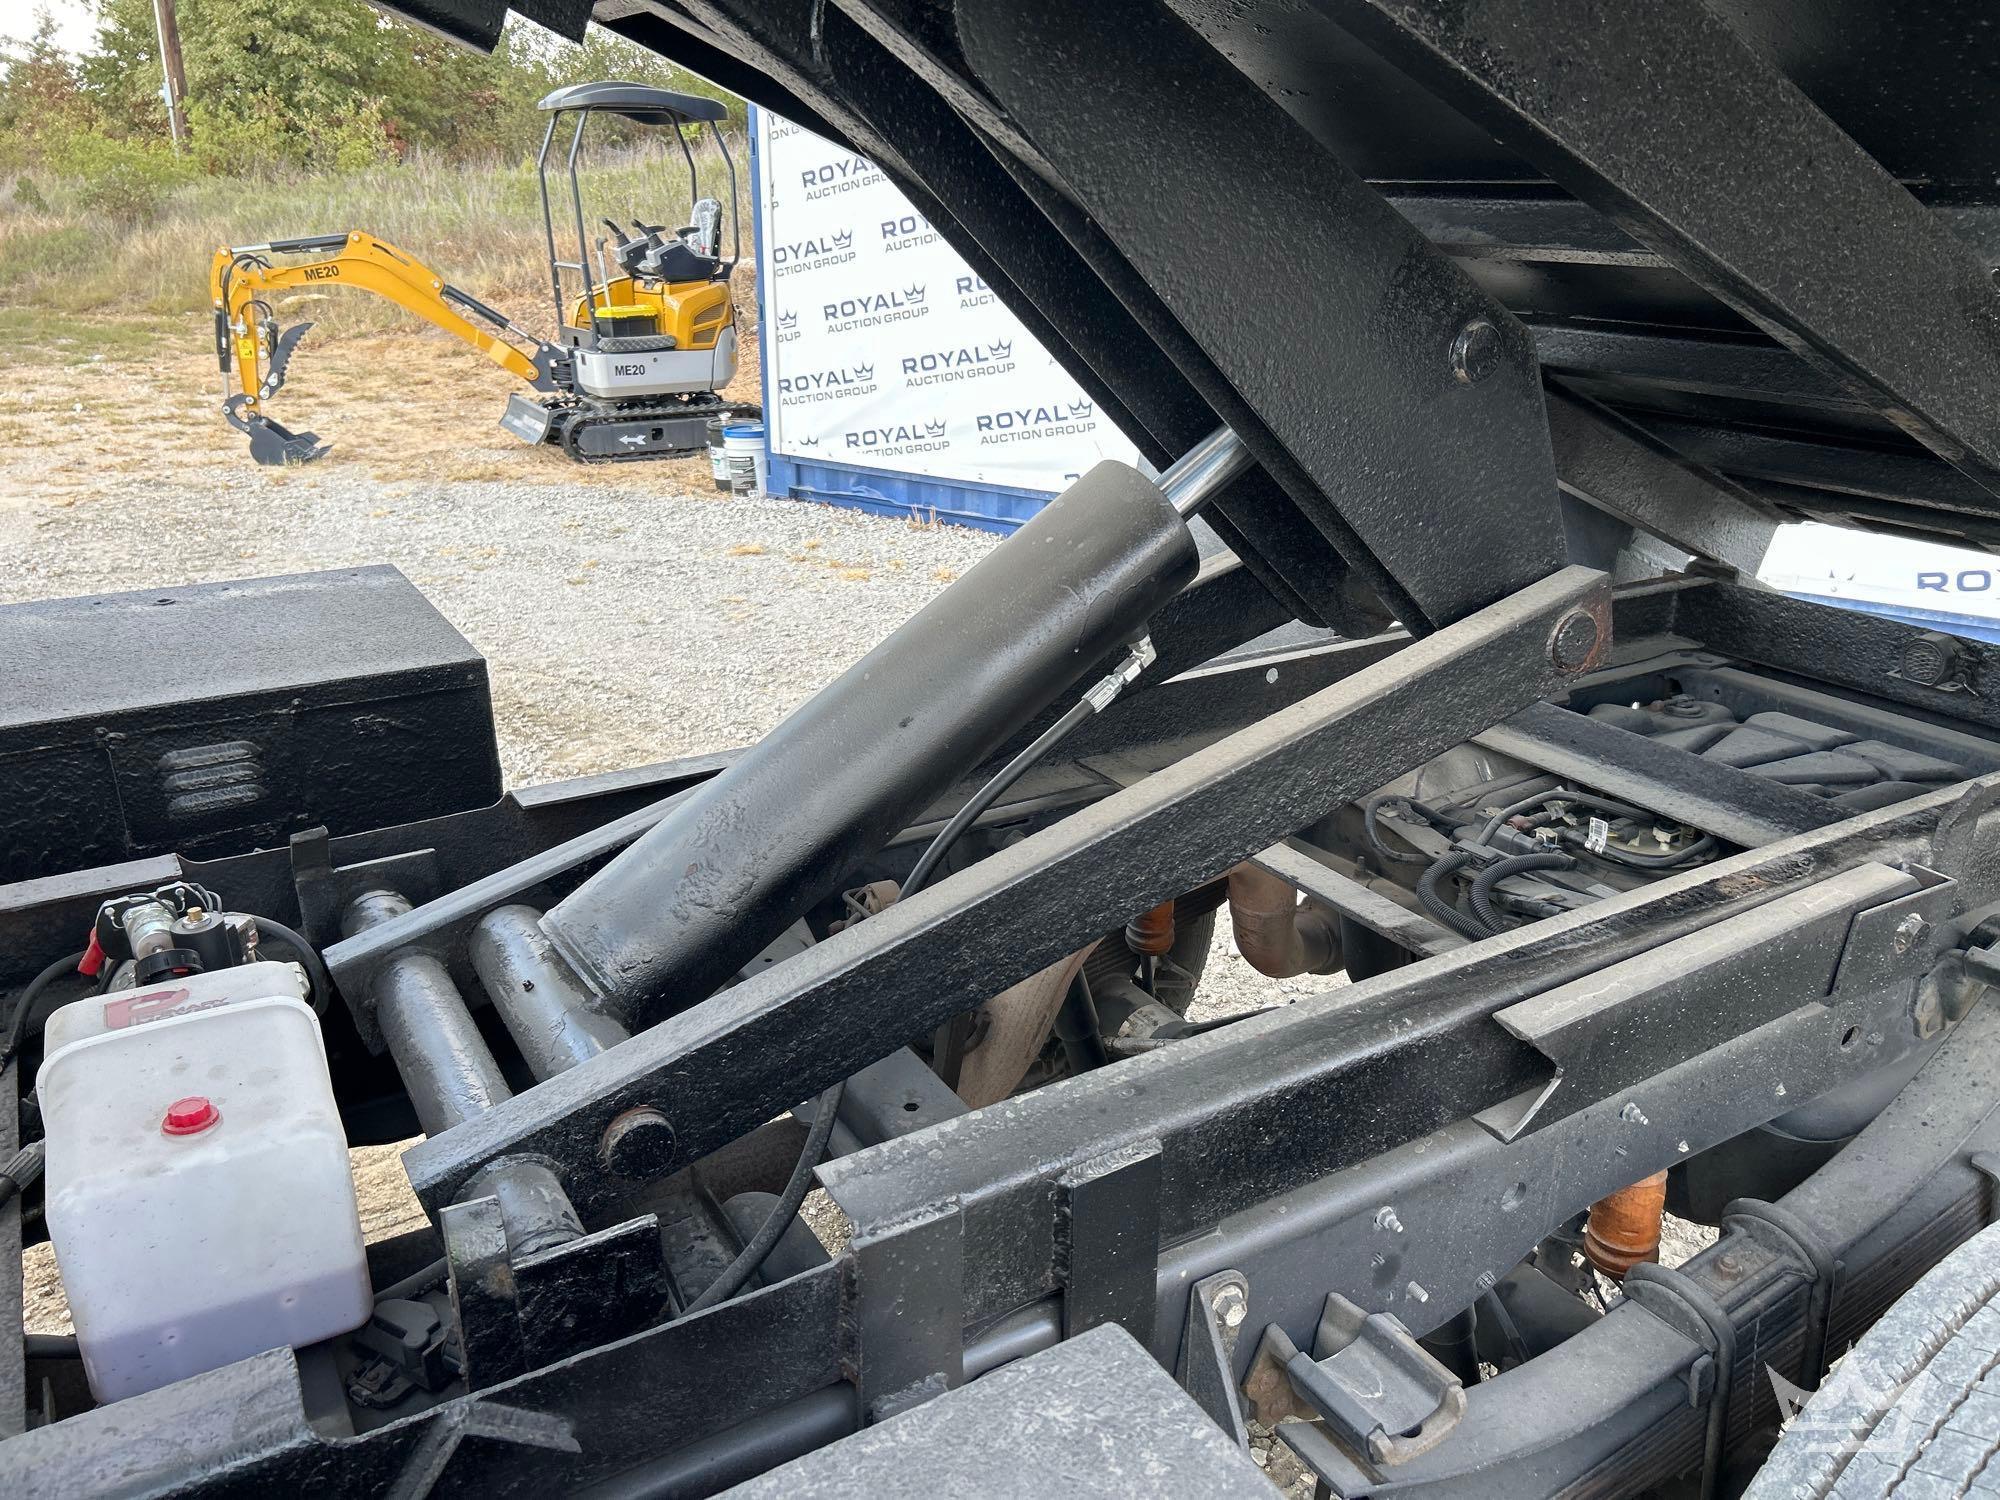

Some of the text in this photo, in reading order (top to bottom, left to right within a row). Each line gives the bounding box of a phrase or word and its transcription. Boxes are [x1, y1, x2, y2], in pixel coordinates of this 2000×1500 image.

[802, 157, 876, 188] ROYA
[806, 179, 860, 201] AUCTION
[881, 214, 930, 239] ROY
[773, 237, 832, 264] OYAL
[304, 265, 339, 281] ME20
[775, 251, 856, 278] CTION GROUP
[823, 291, 904, 321] ROYAL
[960, 294, 995, 310] AUCT
[827, 306, 929, 334] AUCTION GROUP
[777, 331, 801, 343] OUP
[615, 364, 646, 376] ME20
[902, 346, 989, 375] ROYAL
[778, 368, 854, 394] ROYAL
[906, 362, 1016, 388] AUCTION GROUP
[782, 384, 878, 406] AUCTION GROUP
[976, 400, 1068, 431] ROYAL
[845, 425, 925, 448] ROYAL
[980, 417, 1096, 446] AUCTION GROUP
[905, 440, 950, 454] GROUP
[1917, 569, 2000, 593] RO
